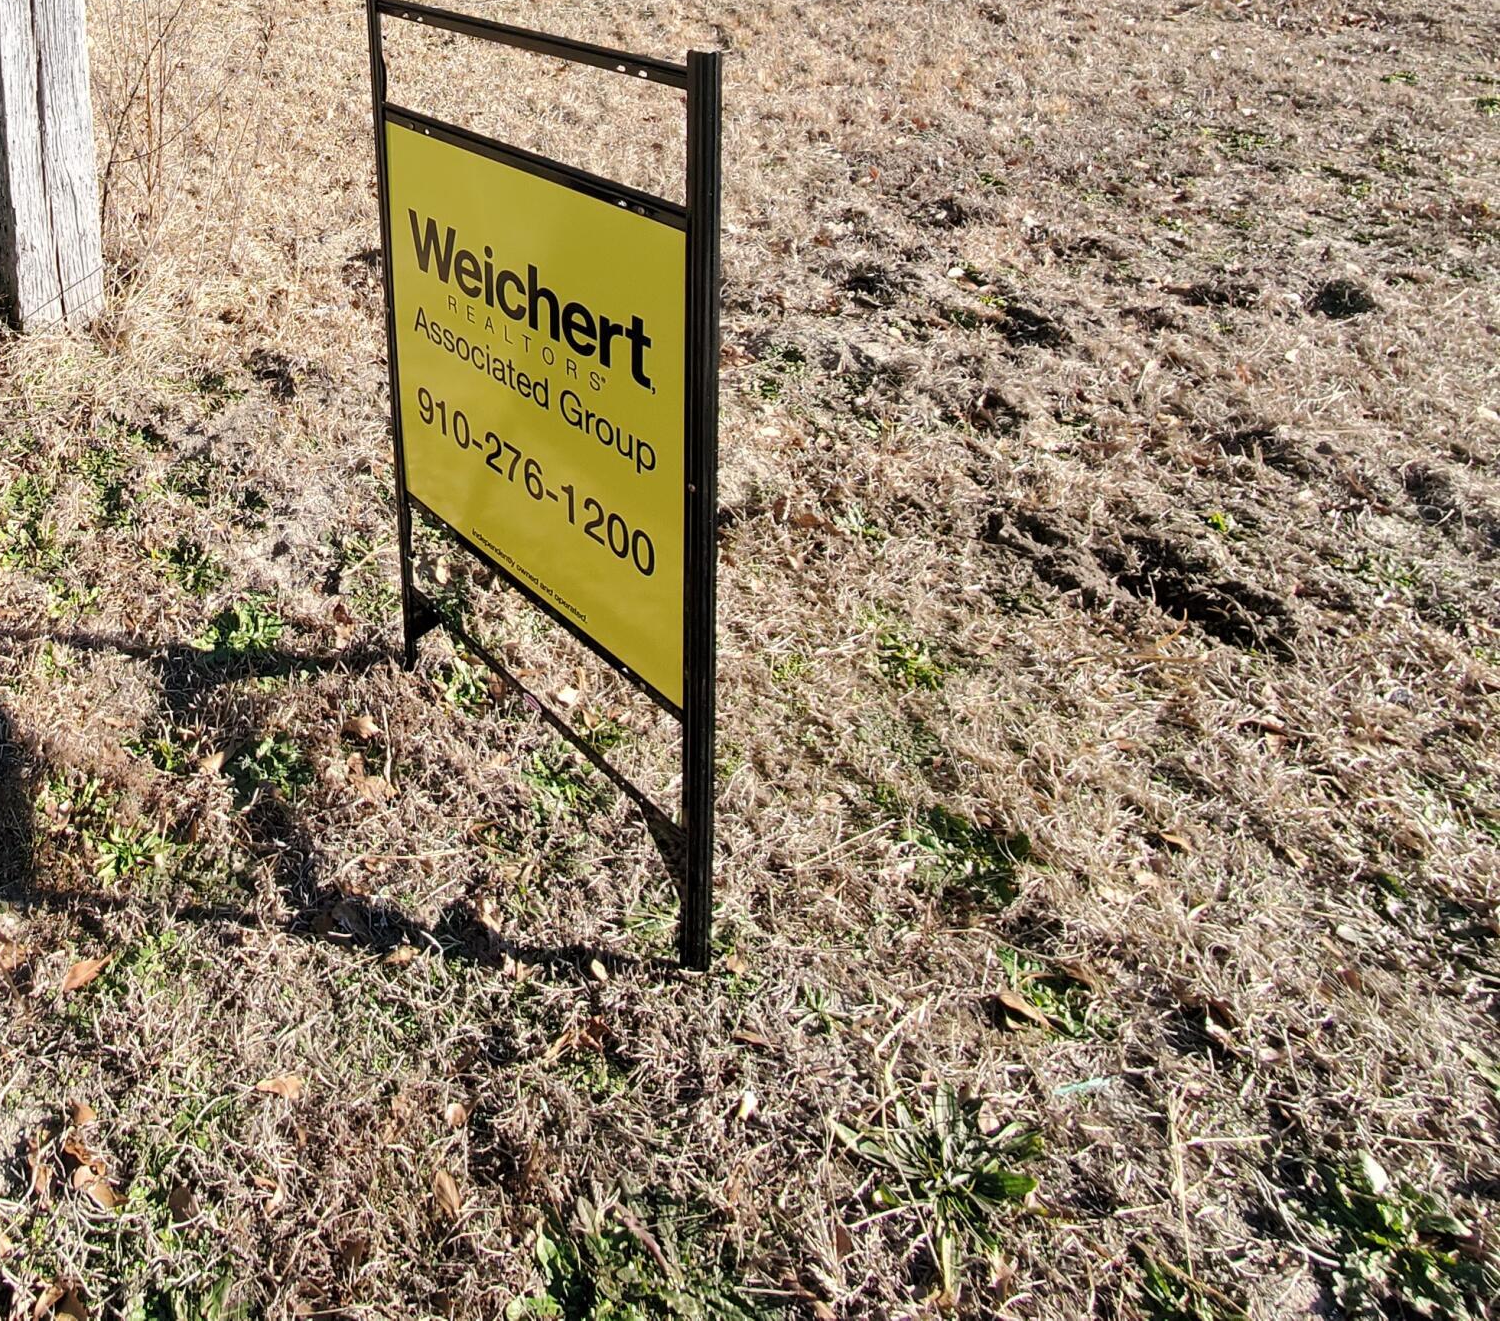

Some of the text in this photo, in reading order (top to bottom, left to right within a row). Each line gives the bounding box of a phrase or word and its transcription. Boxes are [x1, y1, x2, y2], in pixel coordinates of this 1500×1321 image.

[414, 306, 657, 474] Associated Group
[417, 387, 656, 577] 910-276-1200
[516, 564, 539, 585] owned
[539, 582, 554, 597] and
